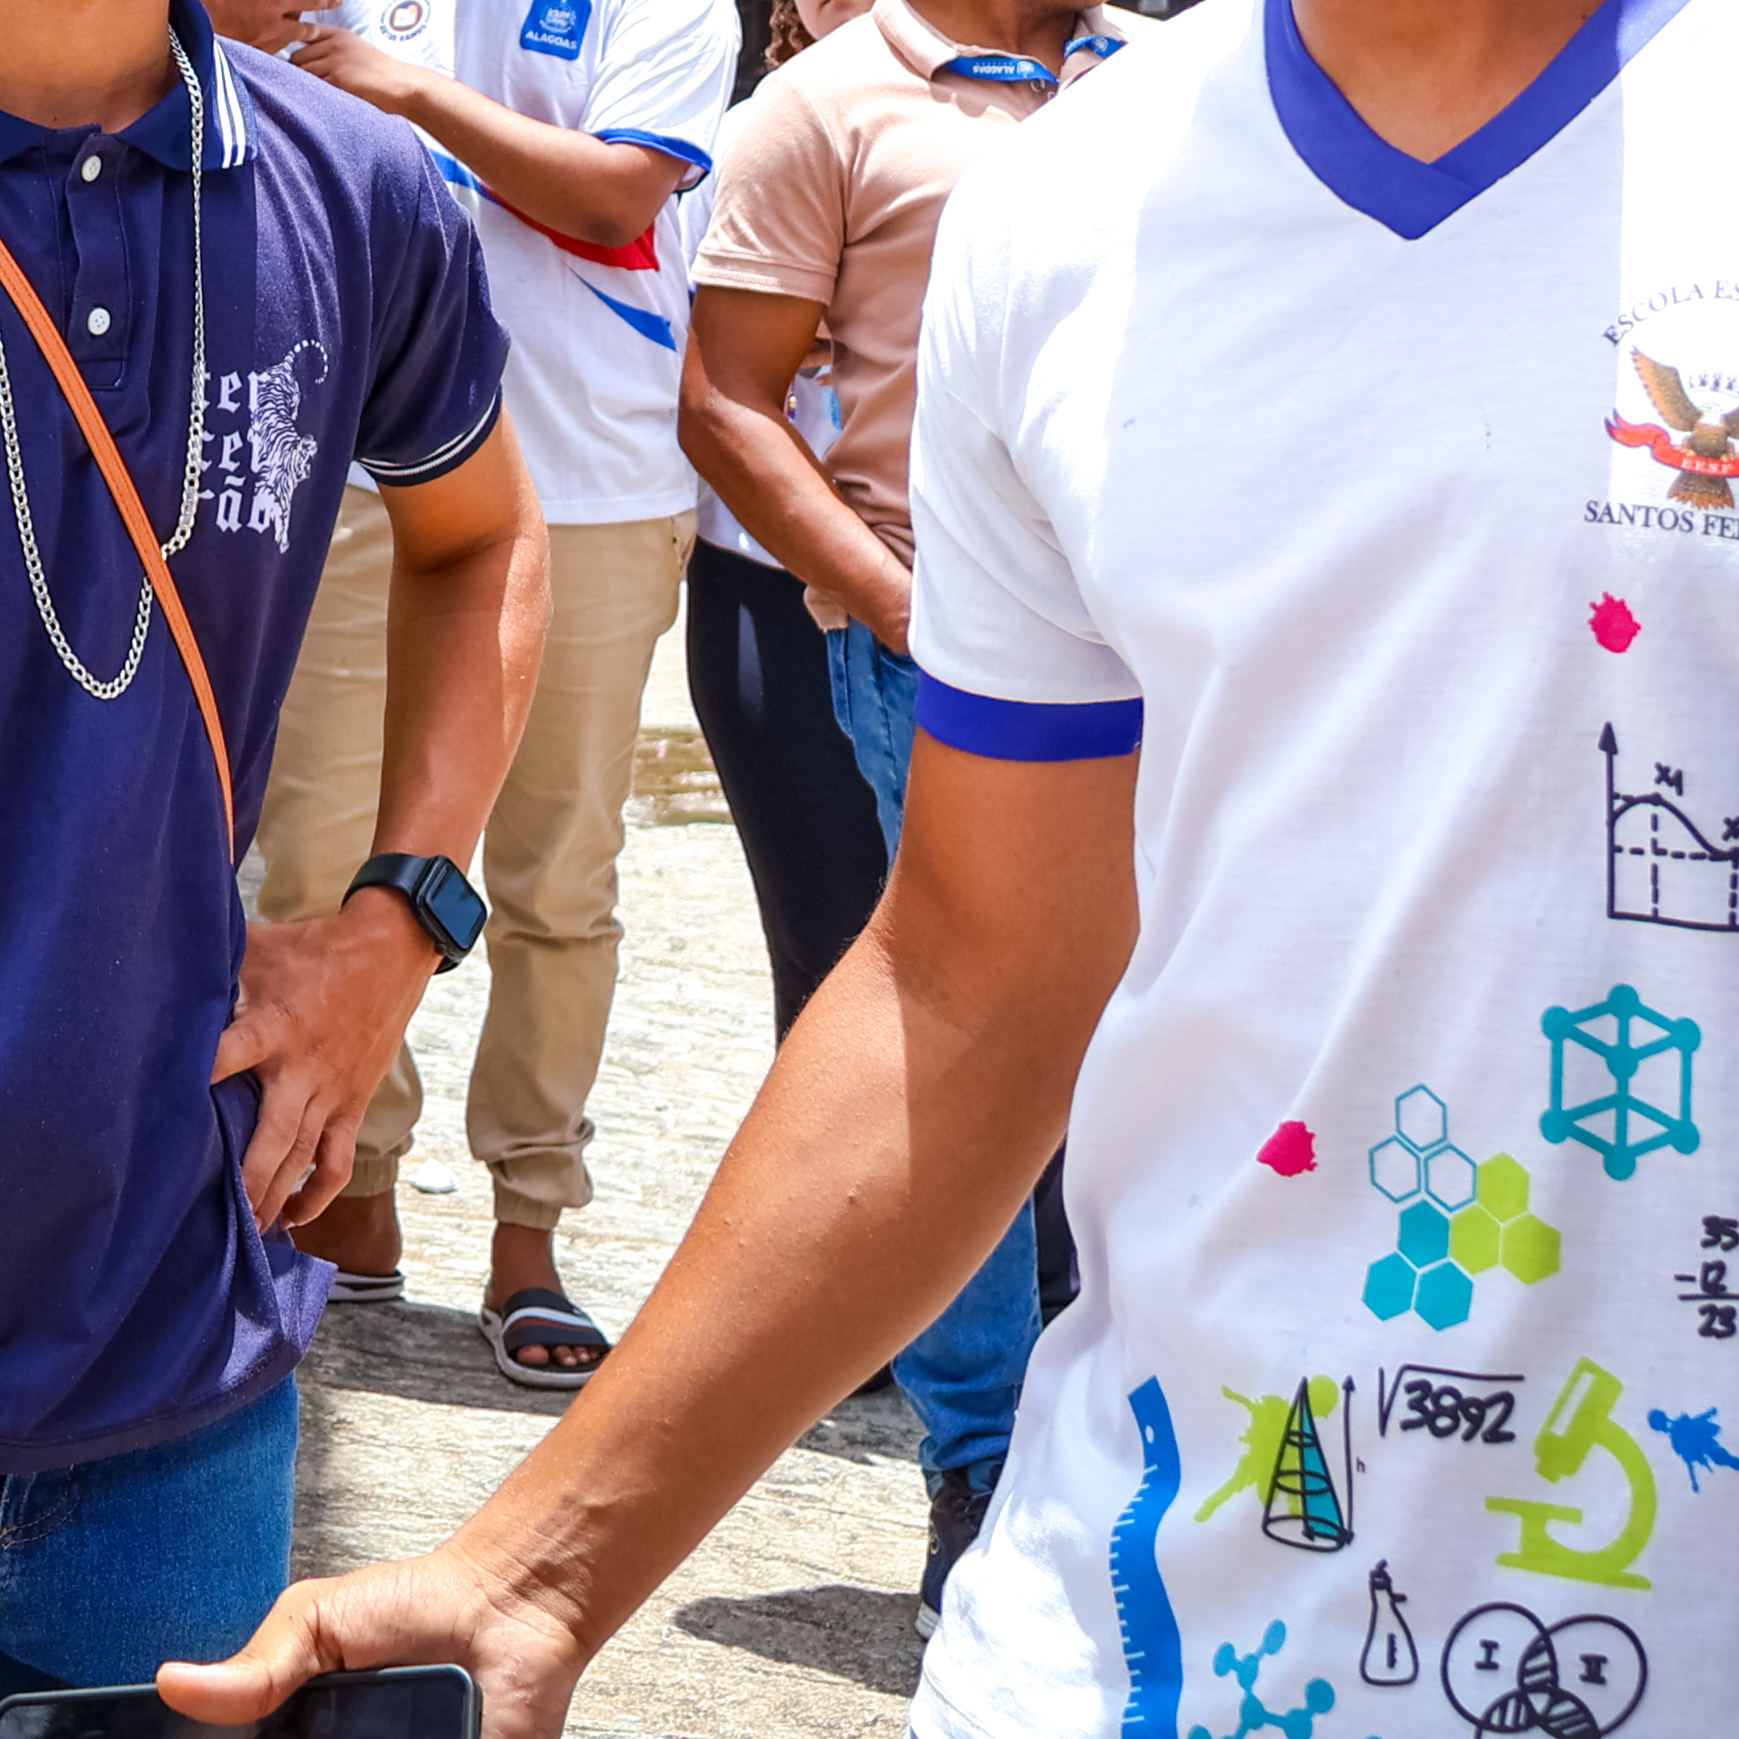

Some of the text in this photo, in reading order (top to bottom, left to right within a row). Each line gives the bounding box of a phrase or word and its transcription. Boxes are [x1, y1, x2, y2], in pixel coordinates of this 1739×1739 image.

[525, 30, 578, 50] ALAGOAS
[973, 65, 1015, 75] ALAGOAS
[1601, 283, 1705, 347] ESCOLA
[1583, 500, 1695, 533] SANTOS
[1697, 1303, 1737, 1339] 23
